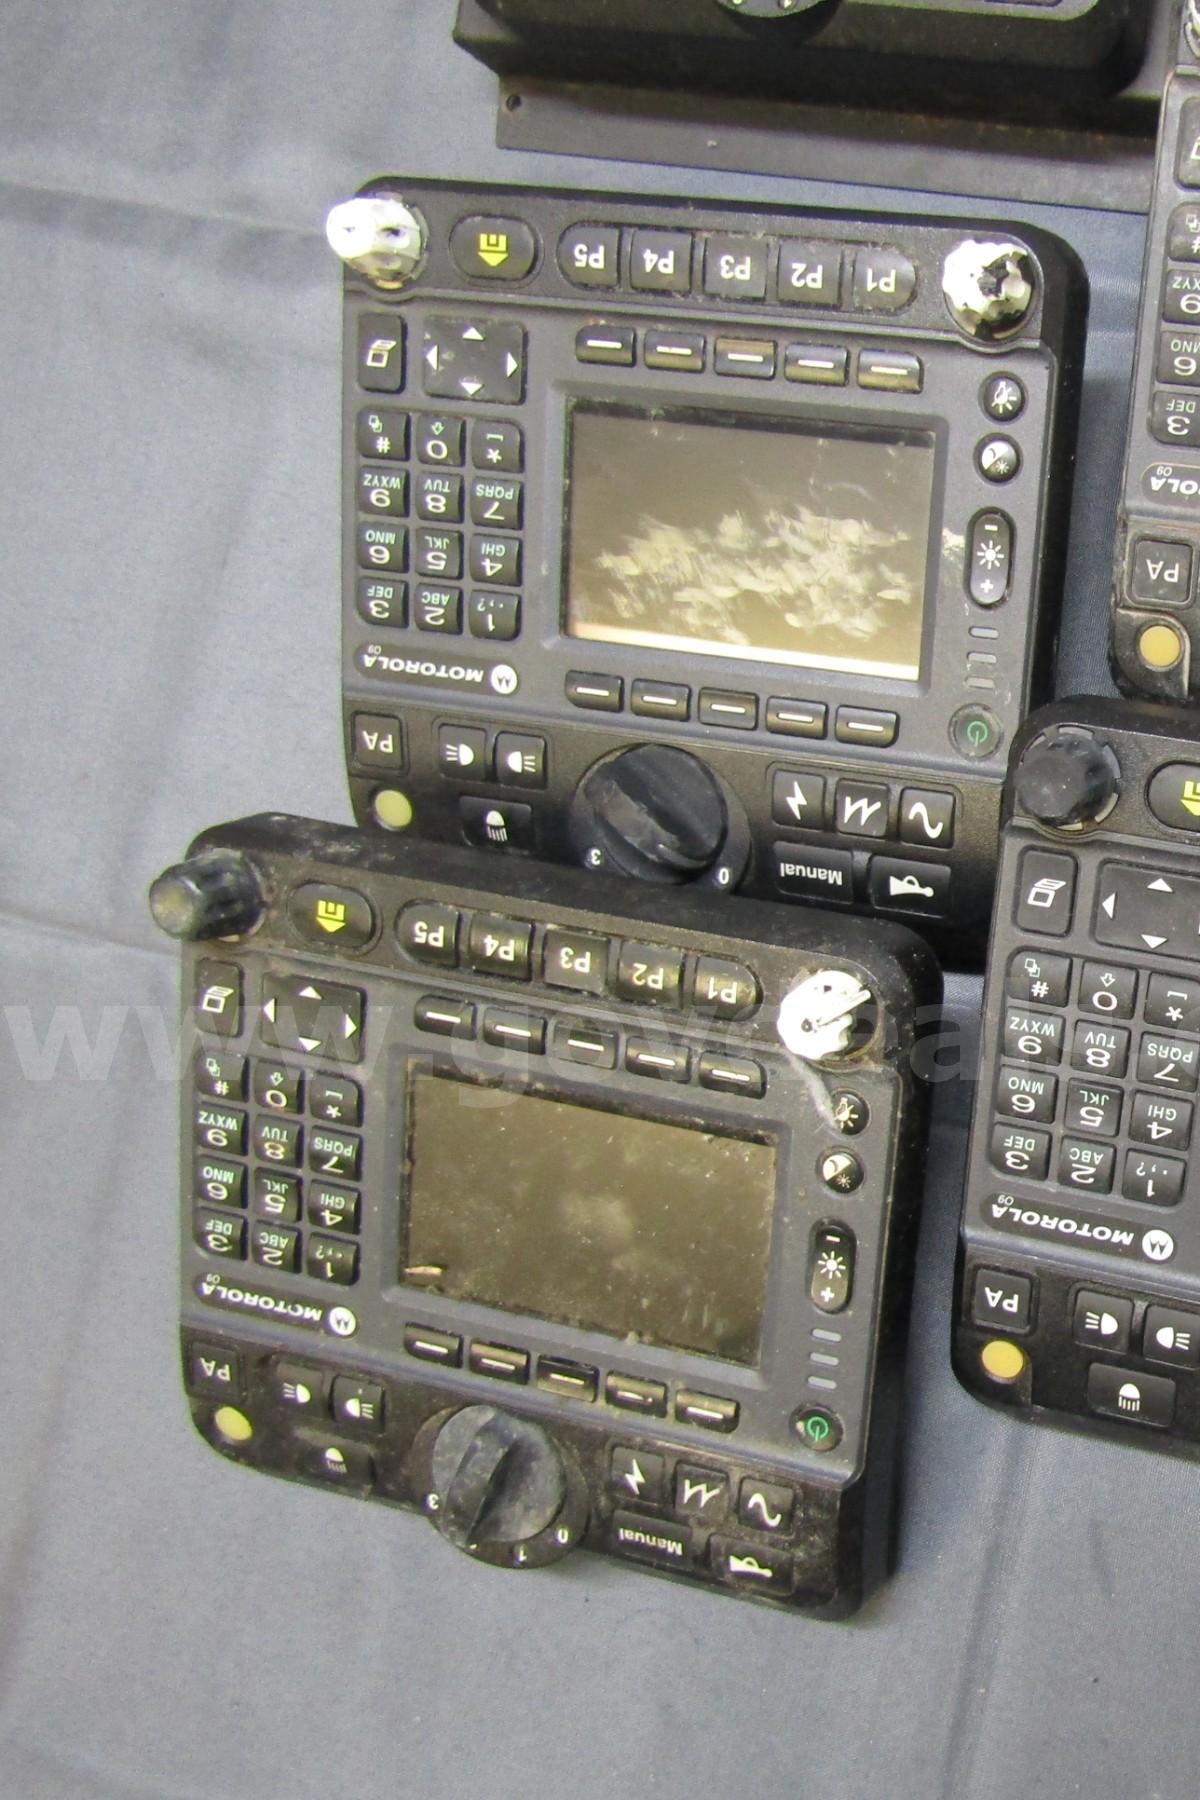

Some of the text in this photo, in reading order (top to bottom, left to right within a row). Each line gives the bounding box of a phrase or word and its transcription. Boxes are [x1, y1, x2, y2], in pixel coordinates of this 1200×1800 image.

[574, 244, 605, 268] P5
[644, 249, 674, 272] P4
[720, 256, 751, 281] P3
[791, 263, 822, 288] P2
[867, 268, 896, 292] P1
[1174, 356, 1196, 375] 6
[1166, 400, 1196, 413] DEF
[1167, 415, 1190, 435] 3
[427, 440, 448, 459] 0
[363, 474, 400, 488] WXYZ
[424, 479, 450, 492] TUV
[370, 489, 391, 507] 9
[476, 484, 513, 498] PQRS
[426, 494, 446, 512] 8
[484, 501, 504, 520] 7
[366, 530, 396, 544] MNO
[424, 536, 450, 549] JKL
[370, 546, 390, 564] 6
[481, 543, 505, 556] GHI
[427, 551, 446, 569] 5
[482, 558, 502, 576] 4
[1145, 559, 1181, 583] PA
[368, 585, 393, 598] DEF
[422, 592, 450, 605] ABC
[370, 600, 390, 618] 3
[424, 606, 444, 625] 2
[488, 614, 495, 631] 1
[363, 654, 483, 682] MOTOROLA
[363, 731, 393, 753] PA
[590, 849, 601, 864] 3
[719, 868, 729, 884] 0
[780, 862, 843, 886] Manual
[414, 921, 445, 947] P5
[484, 935, 515, 960] P4
[560, 947, 591, 973] P3
[633, 963, 664, 989] P2
[707, 977, 738, 1003] P1
[1092, 991, 1118, 1011] 0
[1009, 1016, 1055, 1036] WXYZ
[1018, 1036, 1042, 1055] 9
[1084, 1031, 1116, 1048] TUV
[1086, 1047, 1110, 1067] 8
[1147, 1043, 1193, 1060] PQRS
[1154, 1062, 1180, 1082] 7
[1008, 1077, 1044, 1094] MNO
[265, 1090, 286, 1107] 0
[1011, 1094, 1035, 1113] 6
[1080, 1090, 1109, 1105] JKL
[198, 1112, 237, 1129] WXYZ
[1080, 1106, 1104, 1127] 5
[1148, 1104, 1177, 1120] GHI
[207, 1129, 228, 1146] 9
[262, 1126, 288, 1141] TUV
[1147, 1121, 1173, 1139] 4
[264, 1142, 285, 1159] 8
[314, 1137, 353, 1154] PQRS
[1004, 1135, 1035, 1150] DEF
[1005, 1150, 1029, 1170] 3
[1069, 1147, 1103, 1162] ABC
[322, 1155, 344, 1173] 7
[203, 1166, 234, 1181] MNO
[1071, 1163, 1096, 1184] 2
[207, 1181, 228, 1200] 6
[263, 1179, 288, 1193] JKL
[1147, 1179, 1155, 1196] 1
[265, 1193, 285, 1212] 5
[320, 1193, 345, 1208] GHI
[205, 1219, 232, 1234] DEF
[322, 1209, 342, 1226] 4
[992, 1205, 1134, 1245] MOTOROLA
[207, 1234, 228, 1252] 3
[259, 1232, 289, 1247] ABC
[263, 1248, 283, 1265] 2
[326, 1262, 333, 1277] 1
[202, 1282, 322, 1321] MOTOROLA
[984, 1287, 1020, 1312] PA
[200, 1357, 231, 1382] PA
[427, 1493, 438, 1510] 3
[557, 1529, 568, 1543] 0
[619, 1528, 683, 1556] Manual
[519, 1546, 527, 1562] 1
